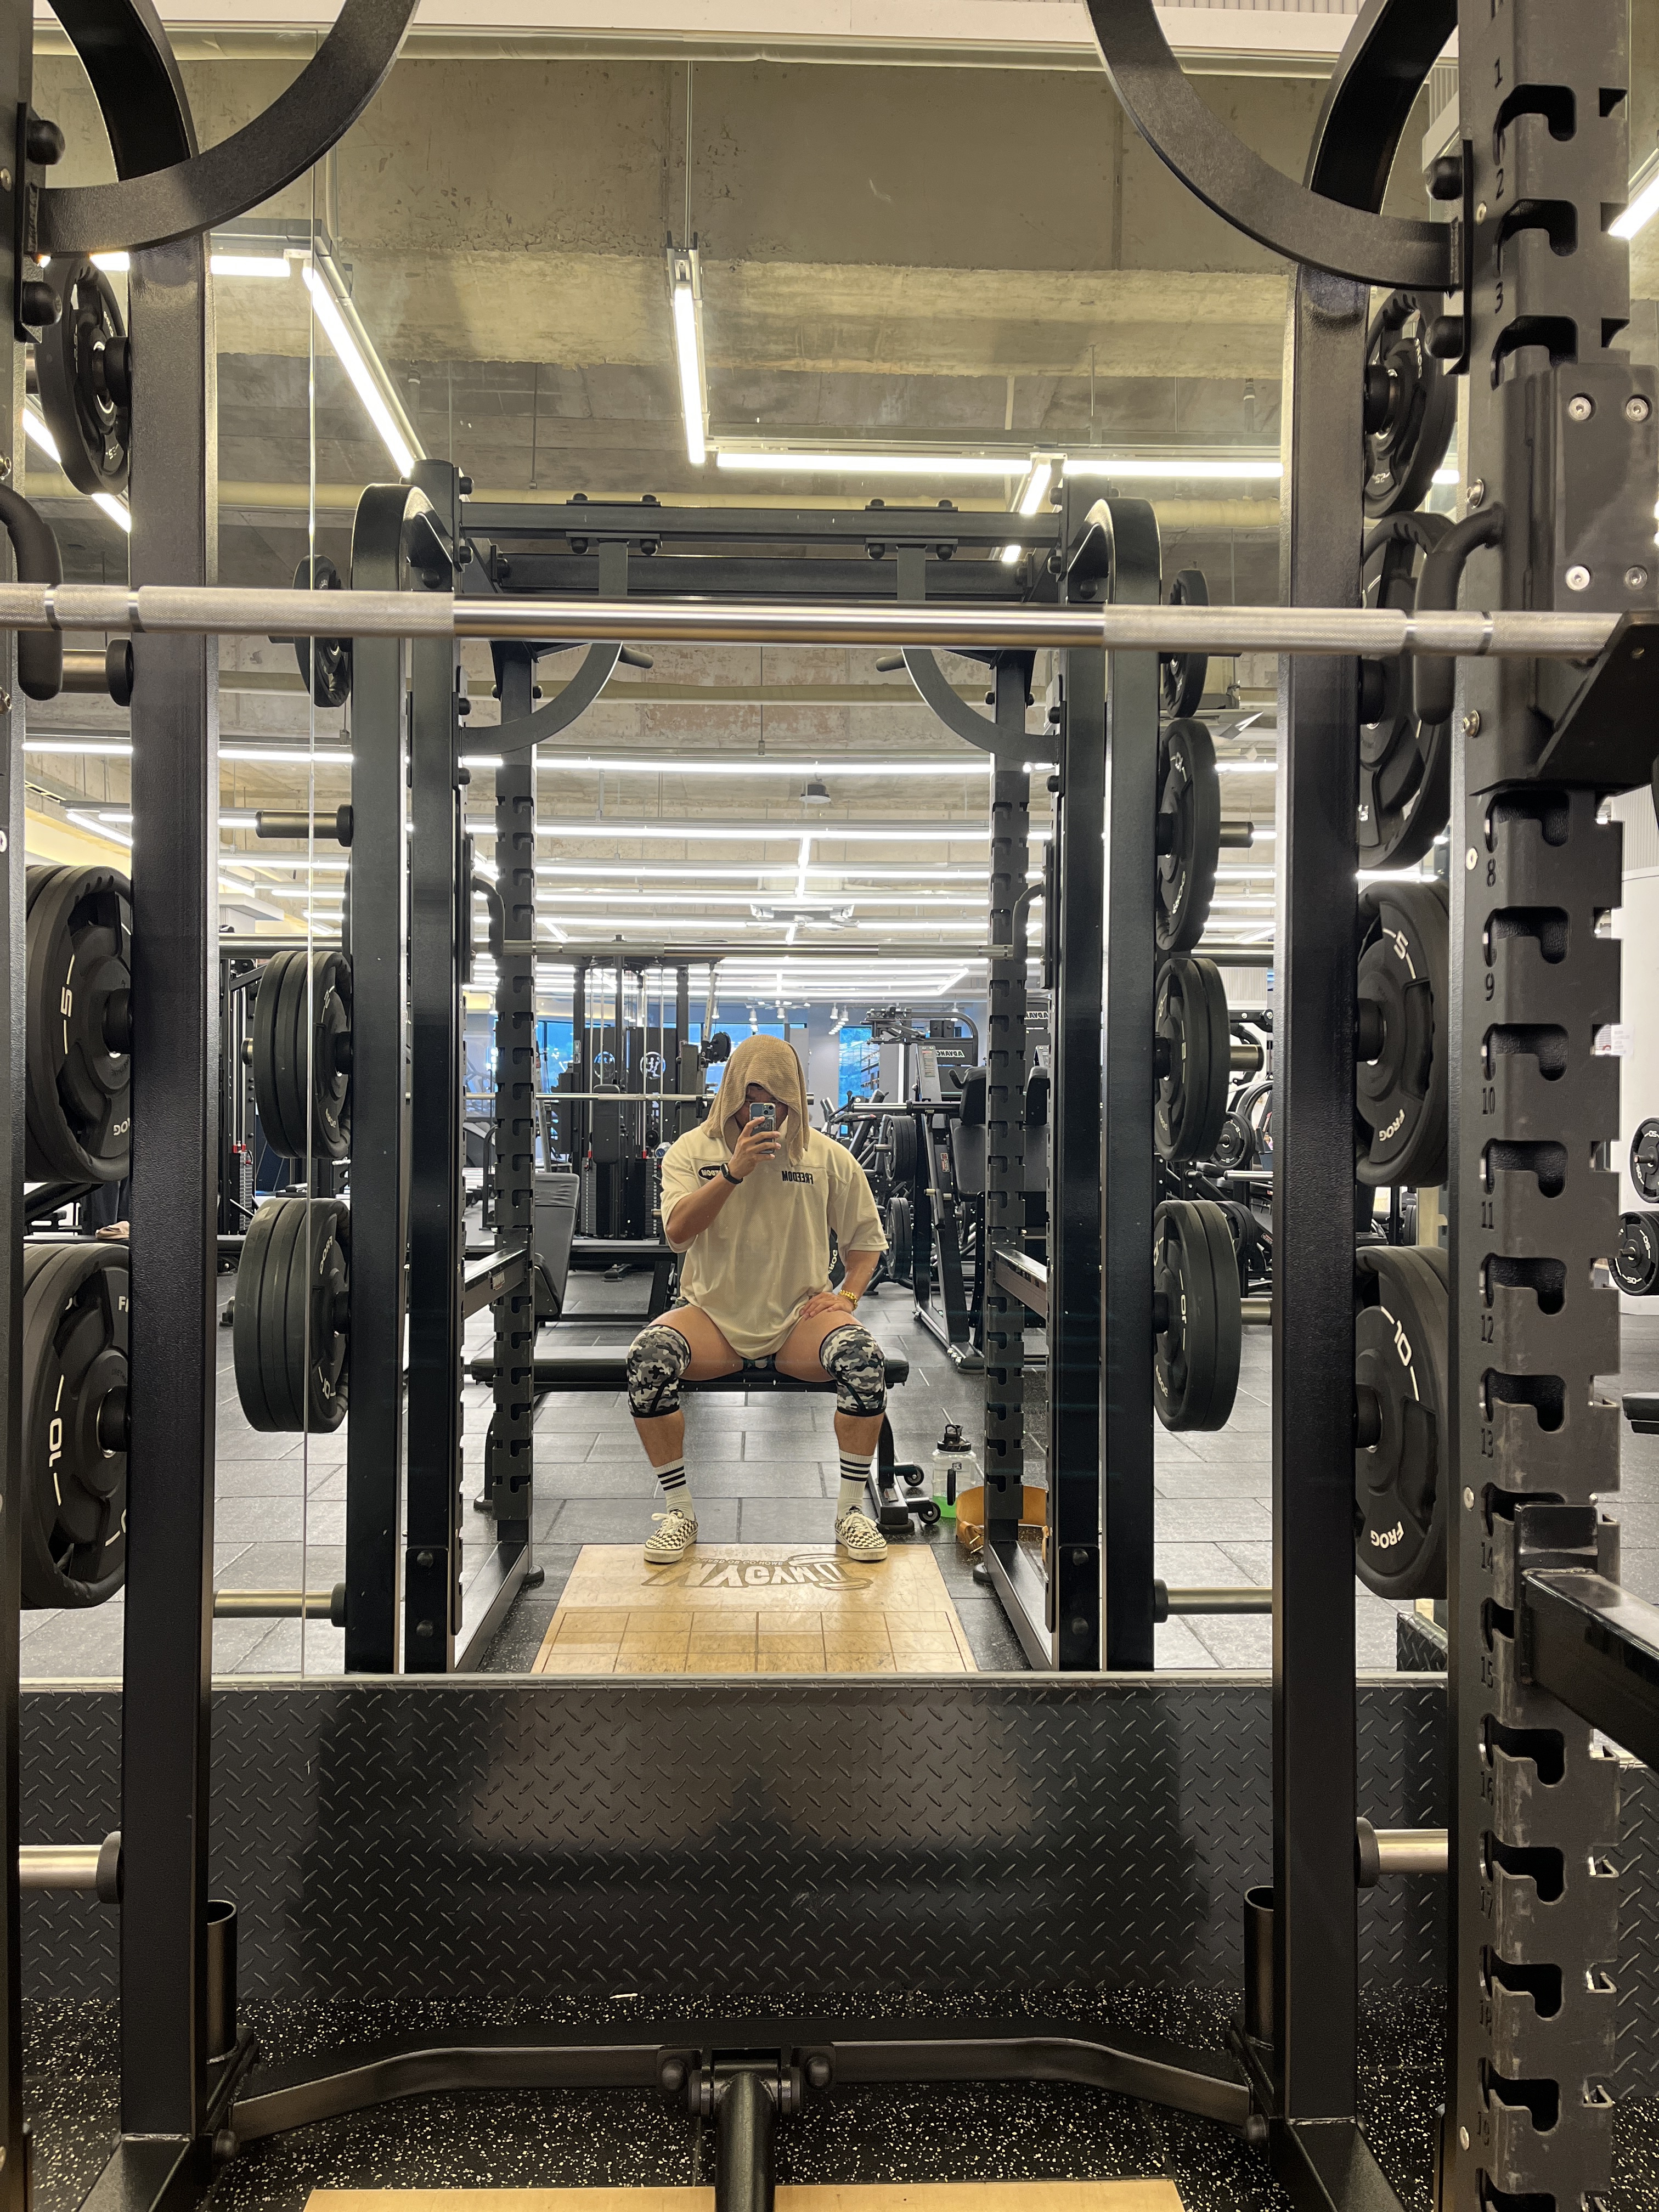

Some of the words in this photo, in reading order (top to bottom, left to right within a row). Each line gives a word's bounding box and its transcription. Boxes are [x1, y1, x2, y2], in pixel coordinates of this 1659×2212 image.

[1494, 57, 1503, 89] 1
[1496, 167, 1505, 201] 2
[1494, 281, 1504, 314] 3
[1486, 857, 1497, 888] 8
[1392, 930, 1409, 960] 5
[60, 986, 73, 1018] 5
[1484, 972, 1496, 1002] 9
[1481, 1086, 1496, 1115] 10
[1379, 1108, 1406, 1142] FROG
[1481, 1200, 1494, 1230] 11
[1392, 1319, 1412, 1366] 10
[1481, 1314, 1494, 1344] 12
[48, 1419, 62, 1468] 10
[1481, 1427, 1493, 1458] 13
[1370, 1521, 1404, 1549] FROG
[1481, 1542, 1493, 1575] 14
[1481, 1655, 1493, 1688] 15
[1480, 1770, 1494, 1806] 16
[1480, 1886, 1493, 1920] 17
